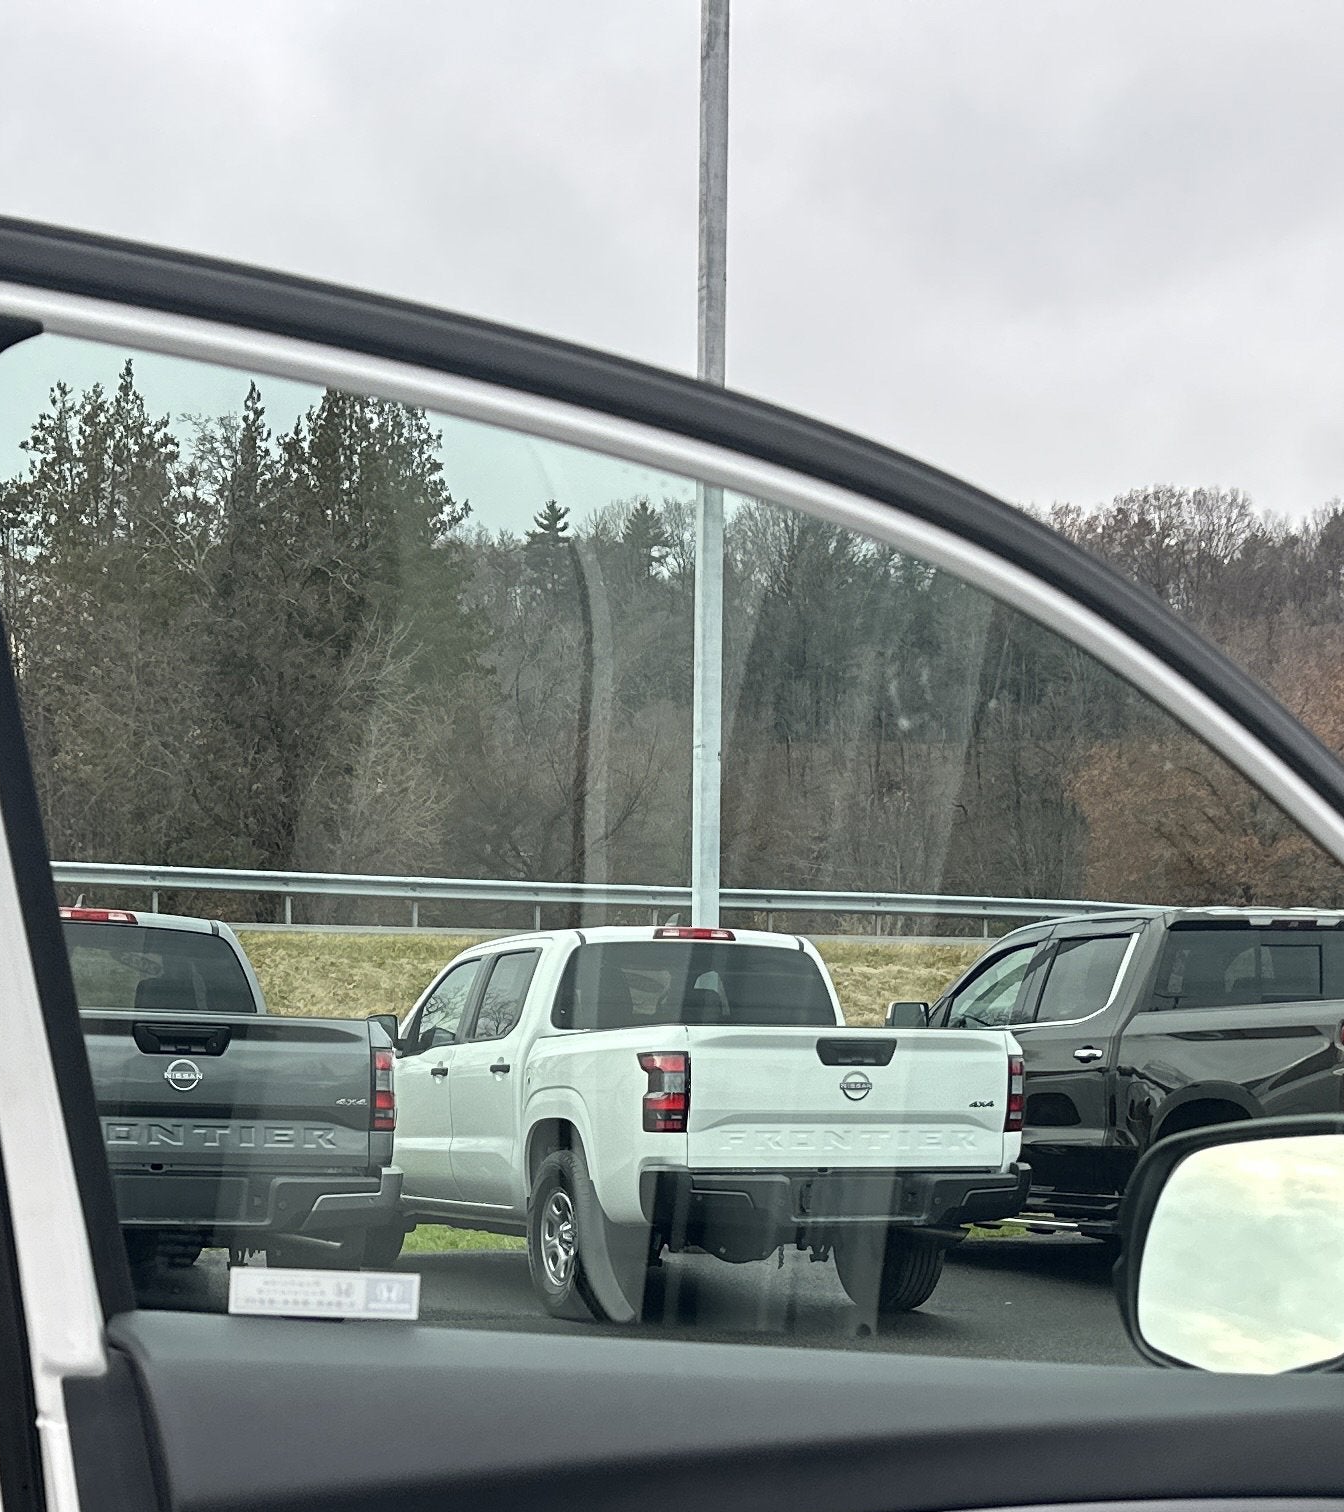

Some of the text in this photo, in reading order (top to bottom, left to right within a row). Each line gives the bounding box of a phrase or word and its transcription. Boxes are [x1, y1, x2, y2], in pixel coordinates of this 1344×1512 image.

[164, 1072, 203, 1080] NISSAN
[106, 1122, 337, 1148] ONTIER
[719, 1130, 978, 1150] FRONTIER
